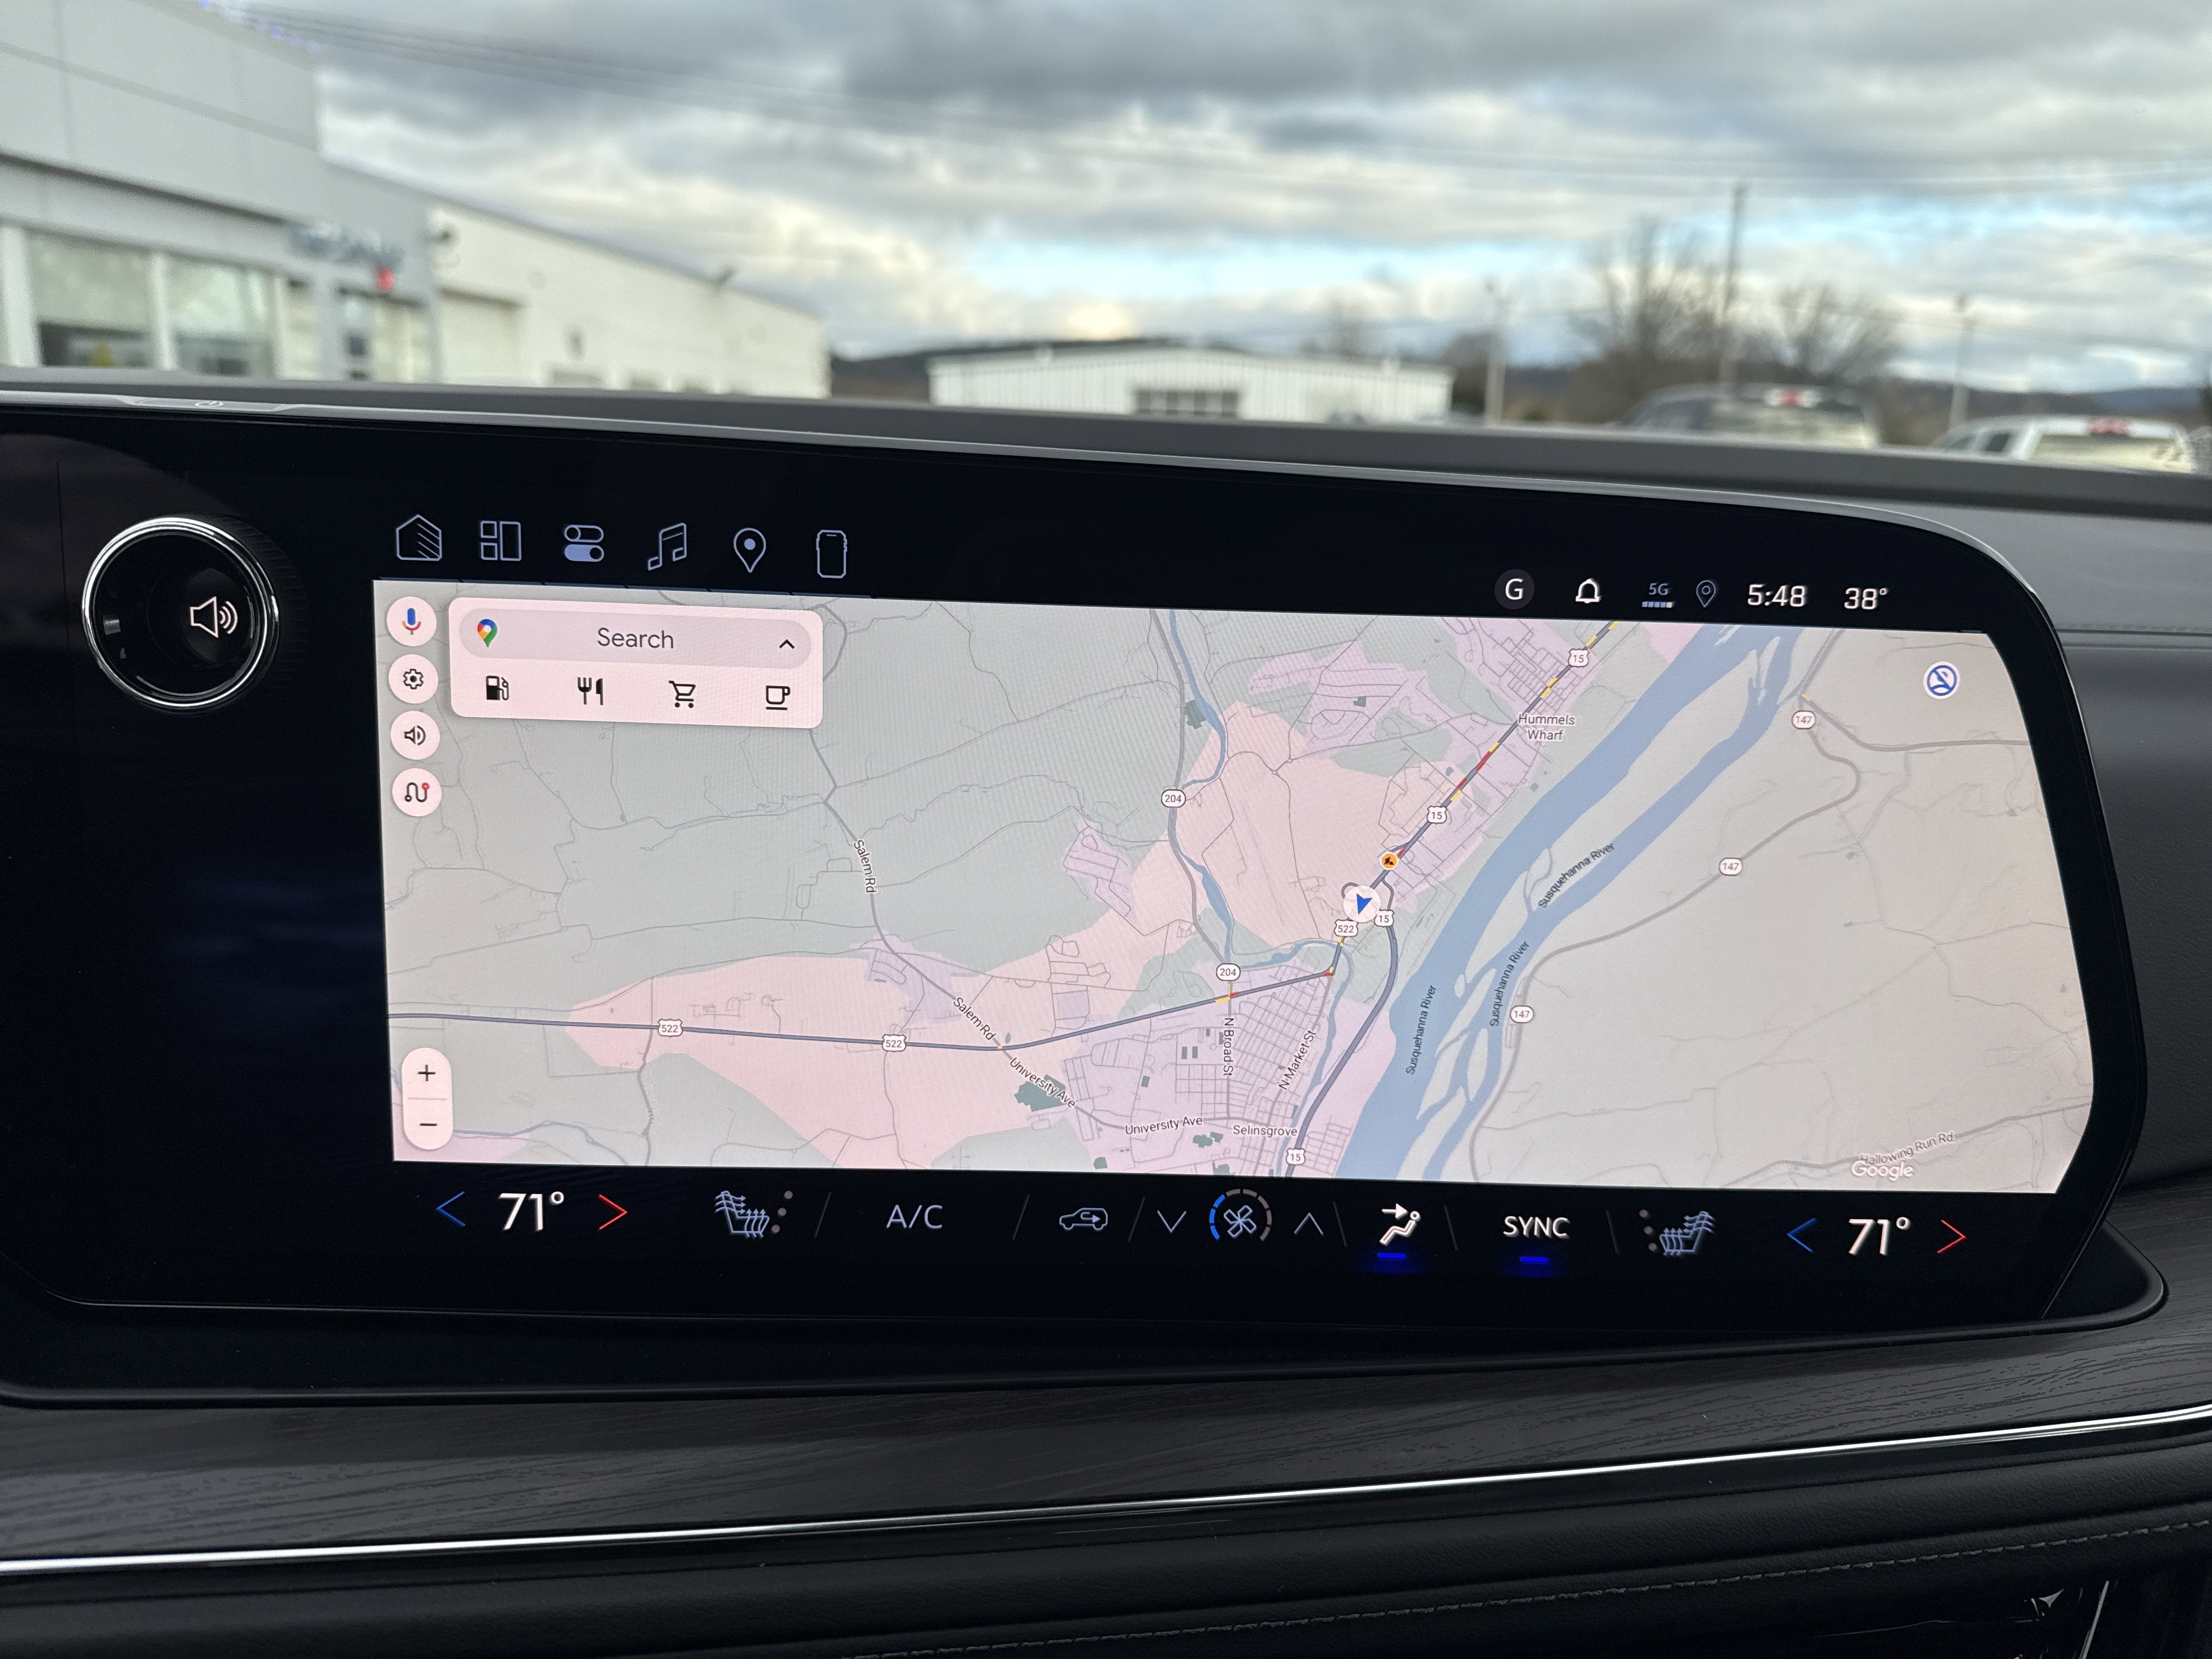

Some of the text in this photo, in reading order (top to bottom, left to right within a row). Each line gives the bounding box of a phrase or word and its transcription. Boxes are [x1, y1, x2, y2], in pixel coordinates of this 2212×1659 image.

[1505, 578, 1523, 600] G
[1649, 583, 1669, 596] 5G
[1748, 584, 1806, 608] 5:48
[597, 627, 674, 650] Search
[1573, 654, 1584, 663] 15
[1518, 713, 1575, 726] Hummels
[1795, 715, 1812, 725] 147
[1528, 729, 1563, 741] Wharf
[1165, 794, 1182, 804] 204
[1431, 811, 1442, 820] 15
[854, 839, 877, 893] Salem Rd
[1722, 862, 1739, 871] 147
[1538, 843, 1615, 908] Susquehanna River
[1379, 915, 1389, 924] 15
[1338, 924, 1354, 934] 522
[1220, 968, 1237, 977] 204
[1489, 940, 1530, 1026] Susquehanna River
[953, 997, 996, 1041] Salem Rd
[1514, 1010, 1531, 1019] 147
[661, 1024, 679, 1034] 522
[1406, 985, 1437, 1075] Susquehanna River
[885, 1039, 902, 1049] 522
[1223, 1018, 1234, 1076] N Broad St
[1278, 1029, 1317, 1090] N Market St
[1010, 1057, 1076, 1108] University Ave
[1125, 1115, 1203, 1136] University Ave
[1232, 1125, 1298, 1138] Selinsgrove
[1914, 1137, 1936, 1152] Run
[1938, 1132, 1954, 1143] Rd
[1290, 1152, 1301, 1161] 15
[1851, 1160, 1914, 1181] Google
[886, 1204, 943, 1230] A/C
[1503, 1216, 1570, 1239] SYNC
